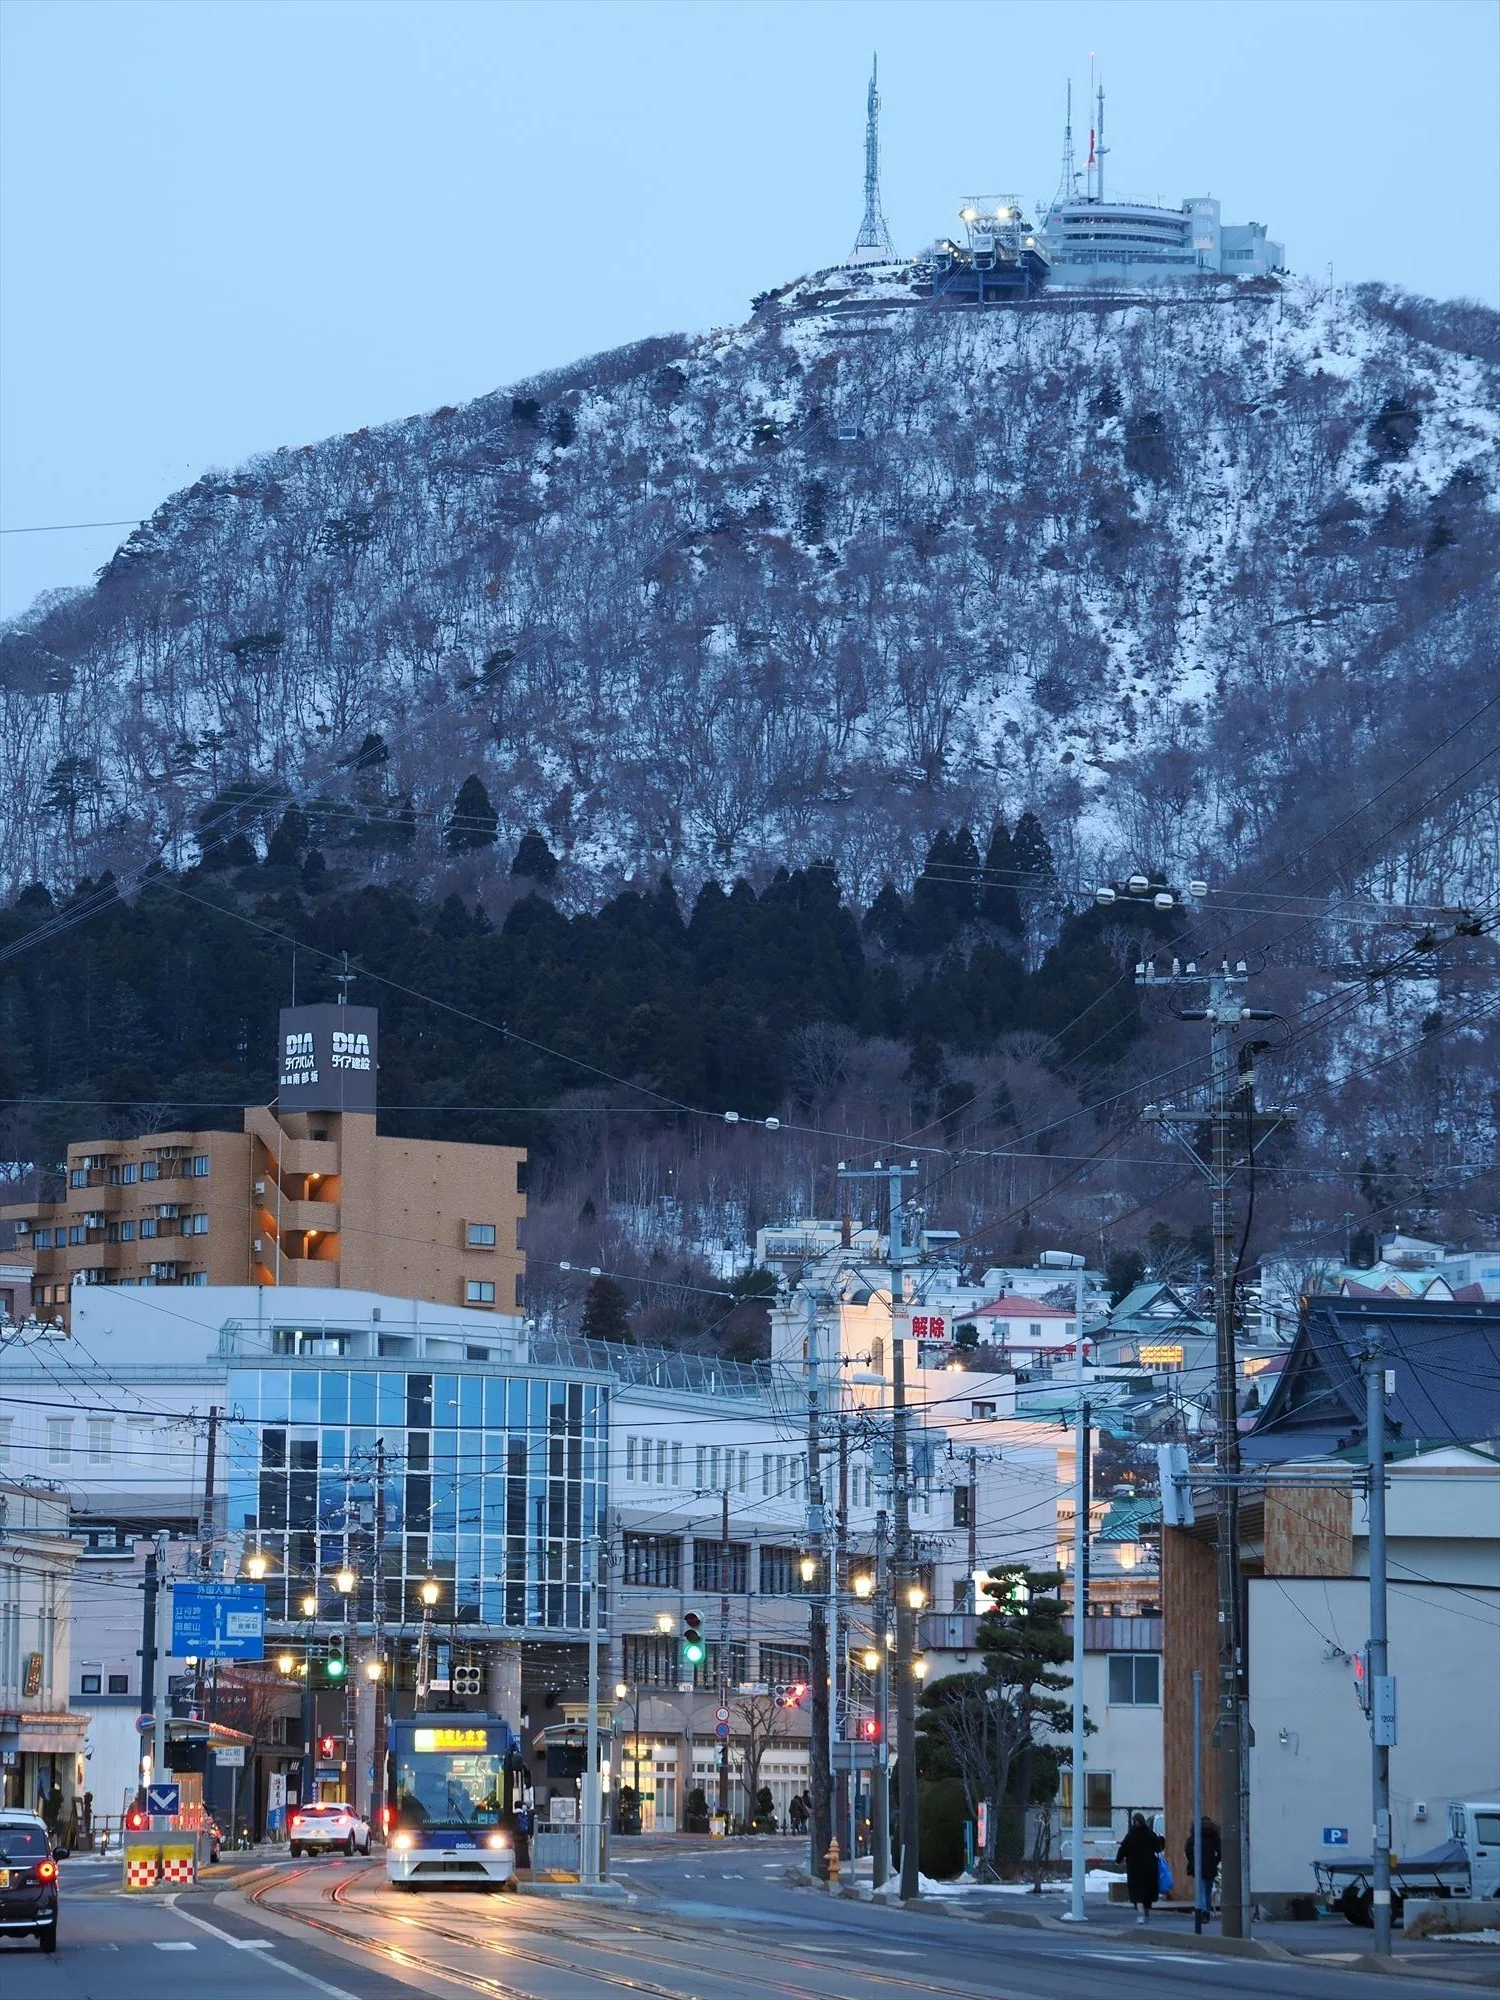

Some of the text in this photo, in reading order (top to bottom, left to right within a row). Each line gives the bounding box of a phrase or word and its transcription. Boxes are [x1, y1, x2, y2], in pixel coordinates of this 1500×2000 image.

[286, 1032, 314, 1055] DIA
[332, 1031, 370, 1055] DIA
[285, 1054, 315, 1071] ダイアパレス
[331, 1054, 371, 1071] ダイア建設
[912, 1316, 945, 1338] 解除
[1331, 1830, 1341, 1842] P
